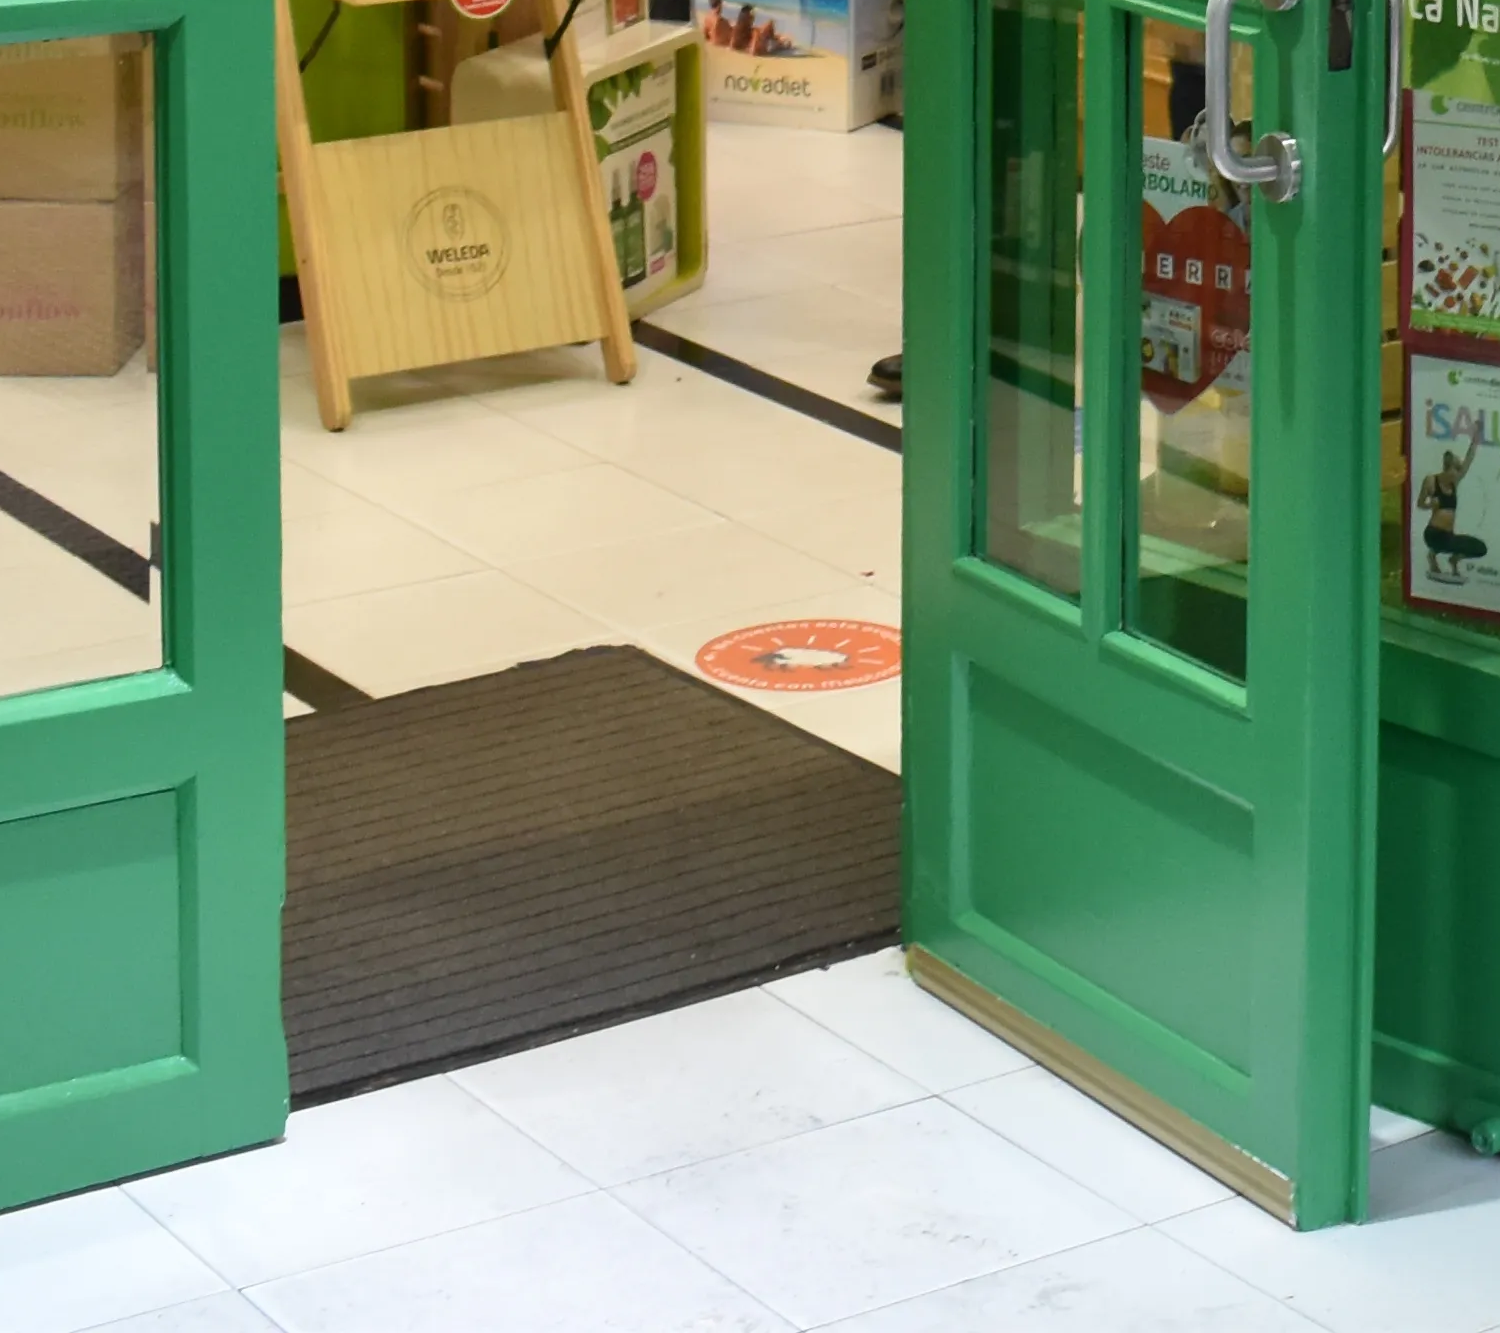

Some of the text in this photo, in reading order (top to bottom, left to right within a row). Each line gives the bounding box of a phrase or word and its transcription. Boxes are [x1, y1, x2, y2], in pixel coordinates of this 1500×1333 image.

[724, 63, 811, 99] novadiet
[1476, 136, 1499, 147] TEST
[425, 242, 492, 264] WELEDA
